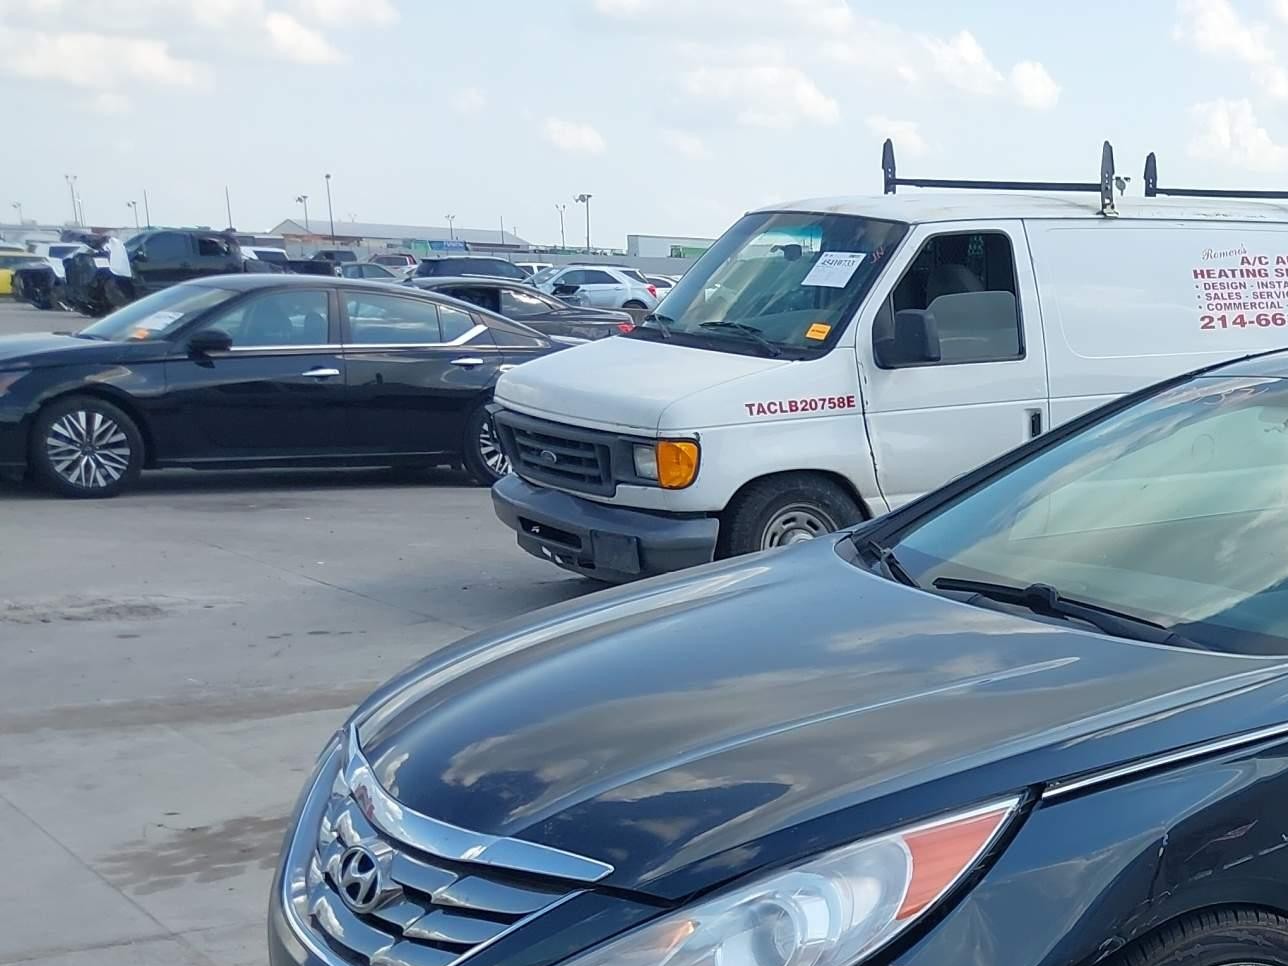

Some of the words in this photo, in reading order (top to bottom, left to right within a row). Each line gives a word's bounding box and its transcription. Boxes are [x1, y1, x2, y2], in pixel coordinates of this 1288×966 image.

[1240, 255, 1270, 266] A/C
[1192, 268, 1269, 279] HEATING
[1203, 281, 1247, 291] DESIGN
[1205, 292, 1242, 301] SALES
[1207, 301, 1283, 311] COMMERCIAL
[745, 396, 856, 416] TACLB20758E
